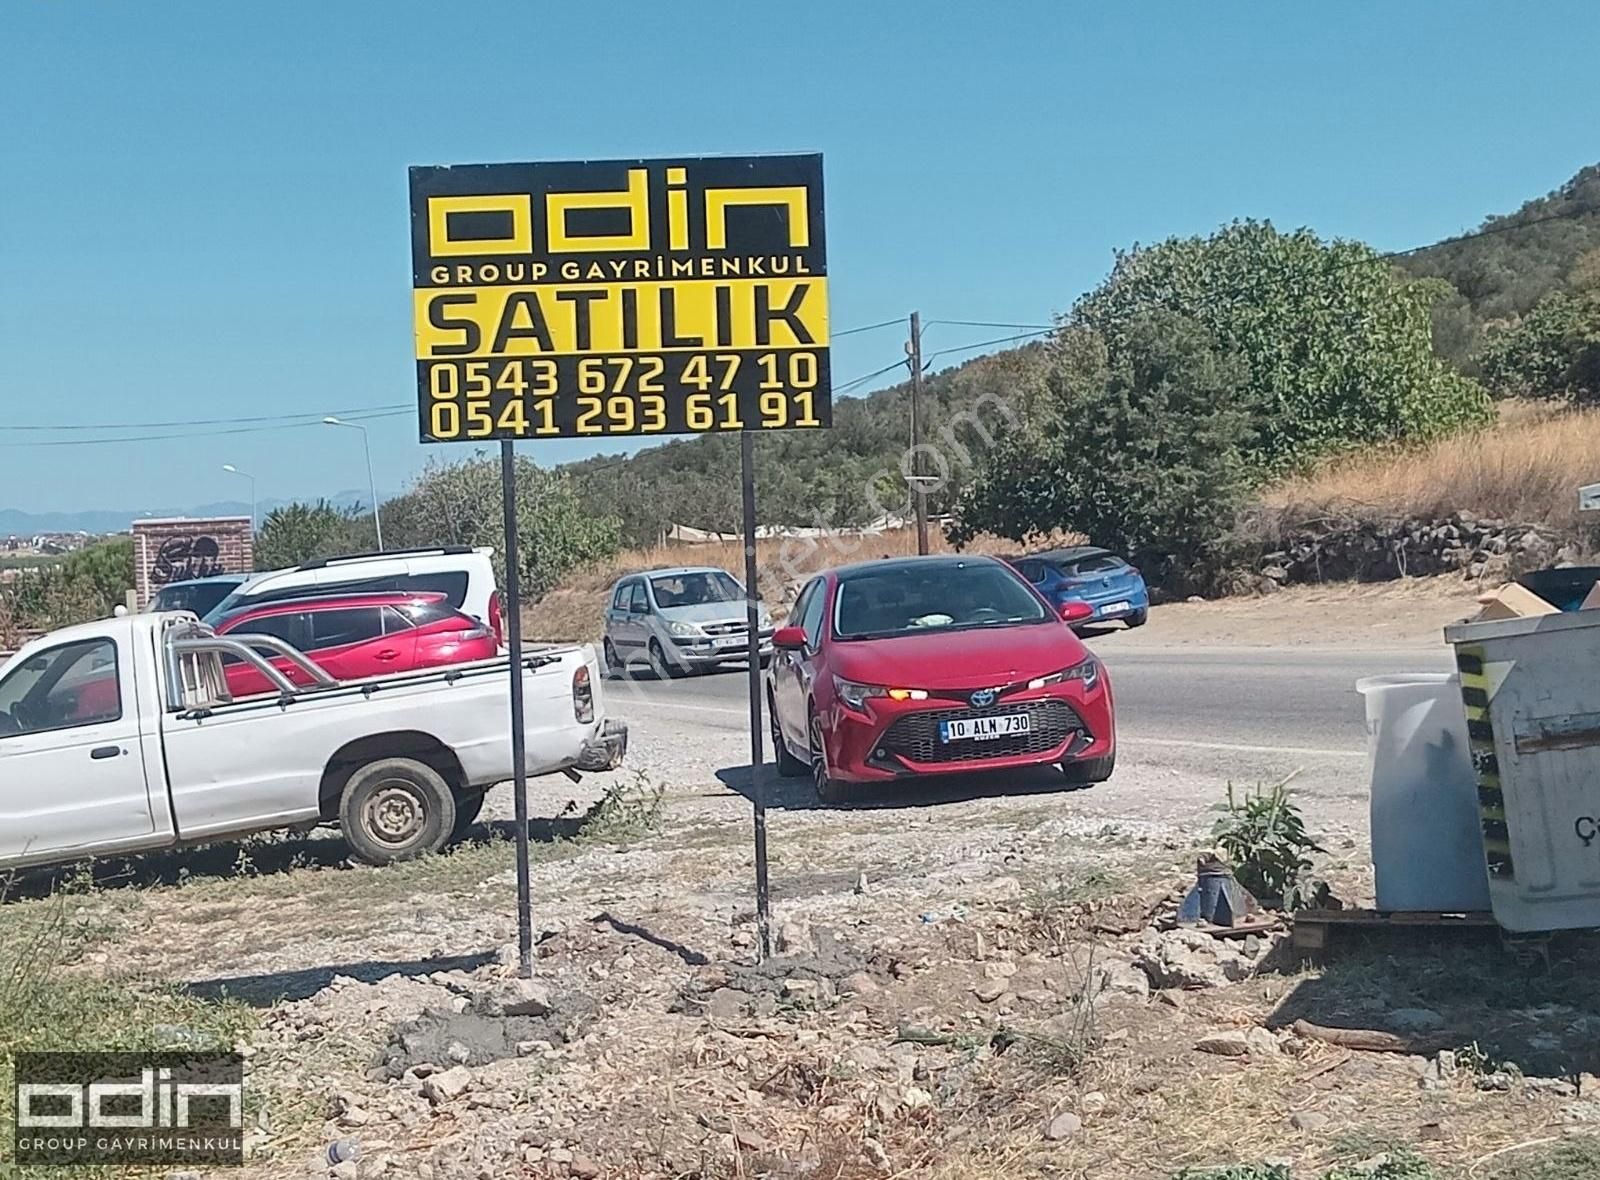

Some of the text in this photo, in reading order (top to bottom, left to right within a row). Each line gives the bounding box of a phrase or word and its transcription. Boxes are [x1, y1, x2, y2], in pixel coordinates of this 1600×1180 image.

[428, 167, 809, 257] odin
[431, 255, 810, 284] GROUP GAYRİMENKUL
[428, 284, 816, 355] SATILIK
[430, 352, 818, 399] 0543 672 47 10
[431, 391, 820, 438] 0541 293 61 91
[950, 722, 965, 737] 10
[974, 718, 997, 735] ALN
[1005, 715, 1028, 732] 730
